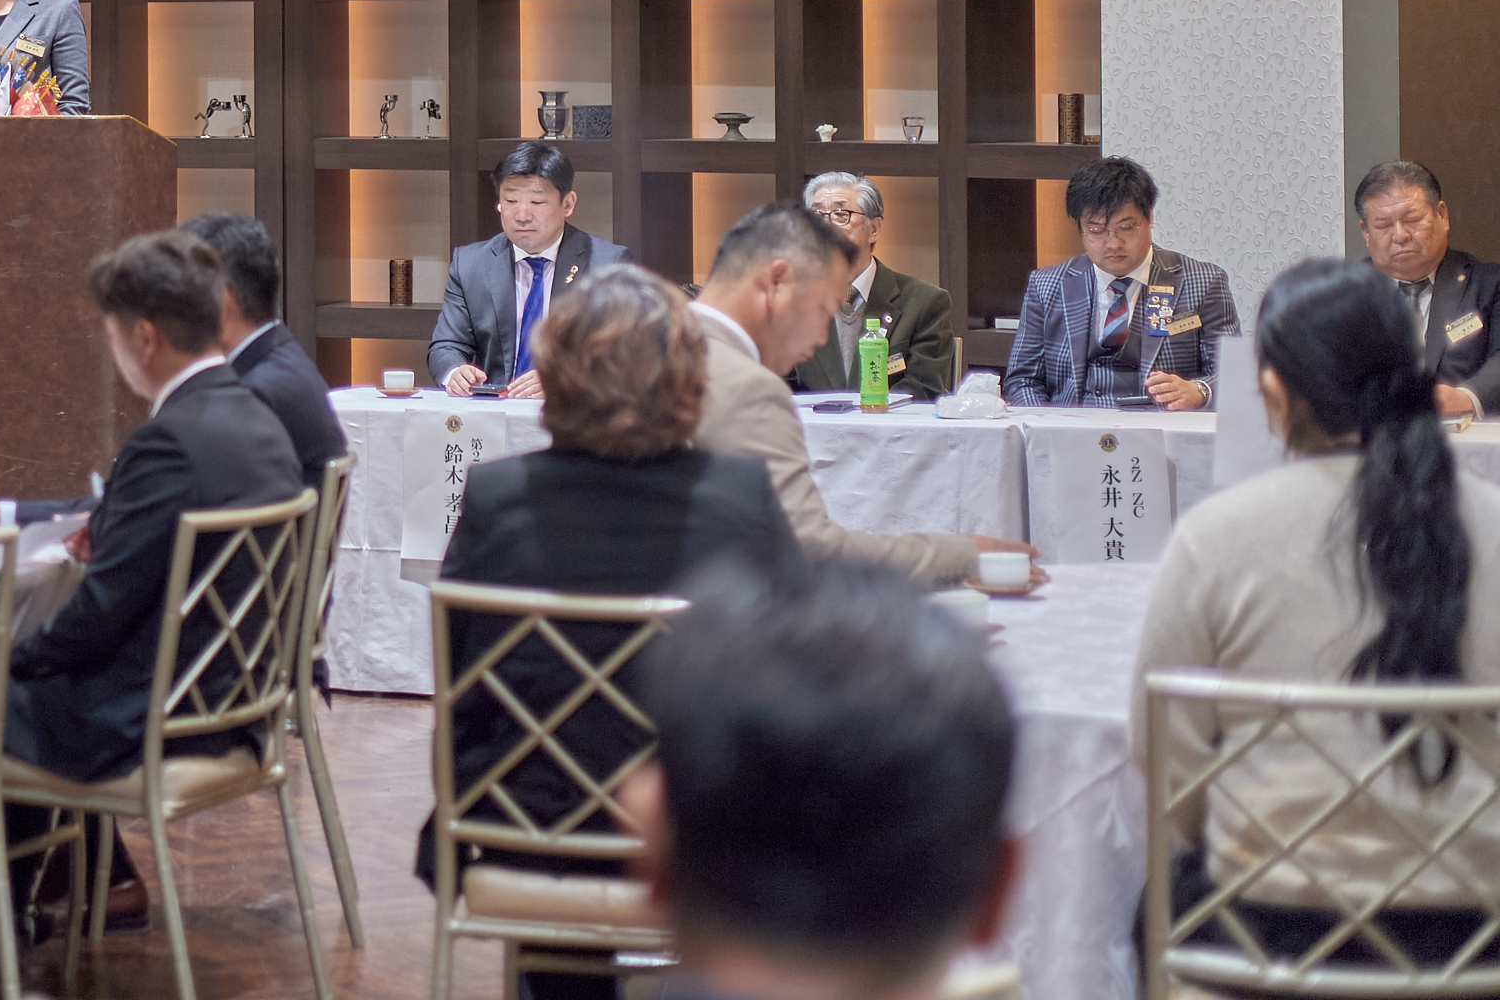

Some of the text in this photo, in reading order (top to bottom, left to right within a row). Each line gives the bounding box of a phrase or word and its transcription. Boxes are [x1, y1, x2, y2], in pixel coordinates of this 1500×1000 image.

[444, 443, 464, 485] 鈴木
[1100, 464, 1125, 561] 永井 大貴
[1132, 492, 1145, 519] ZC
